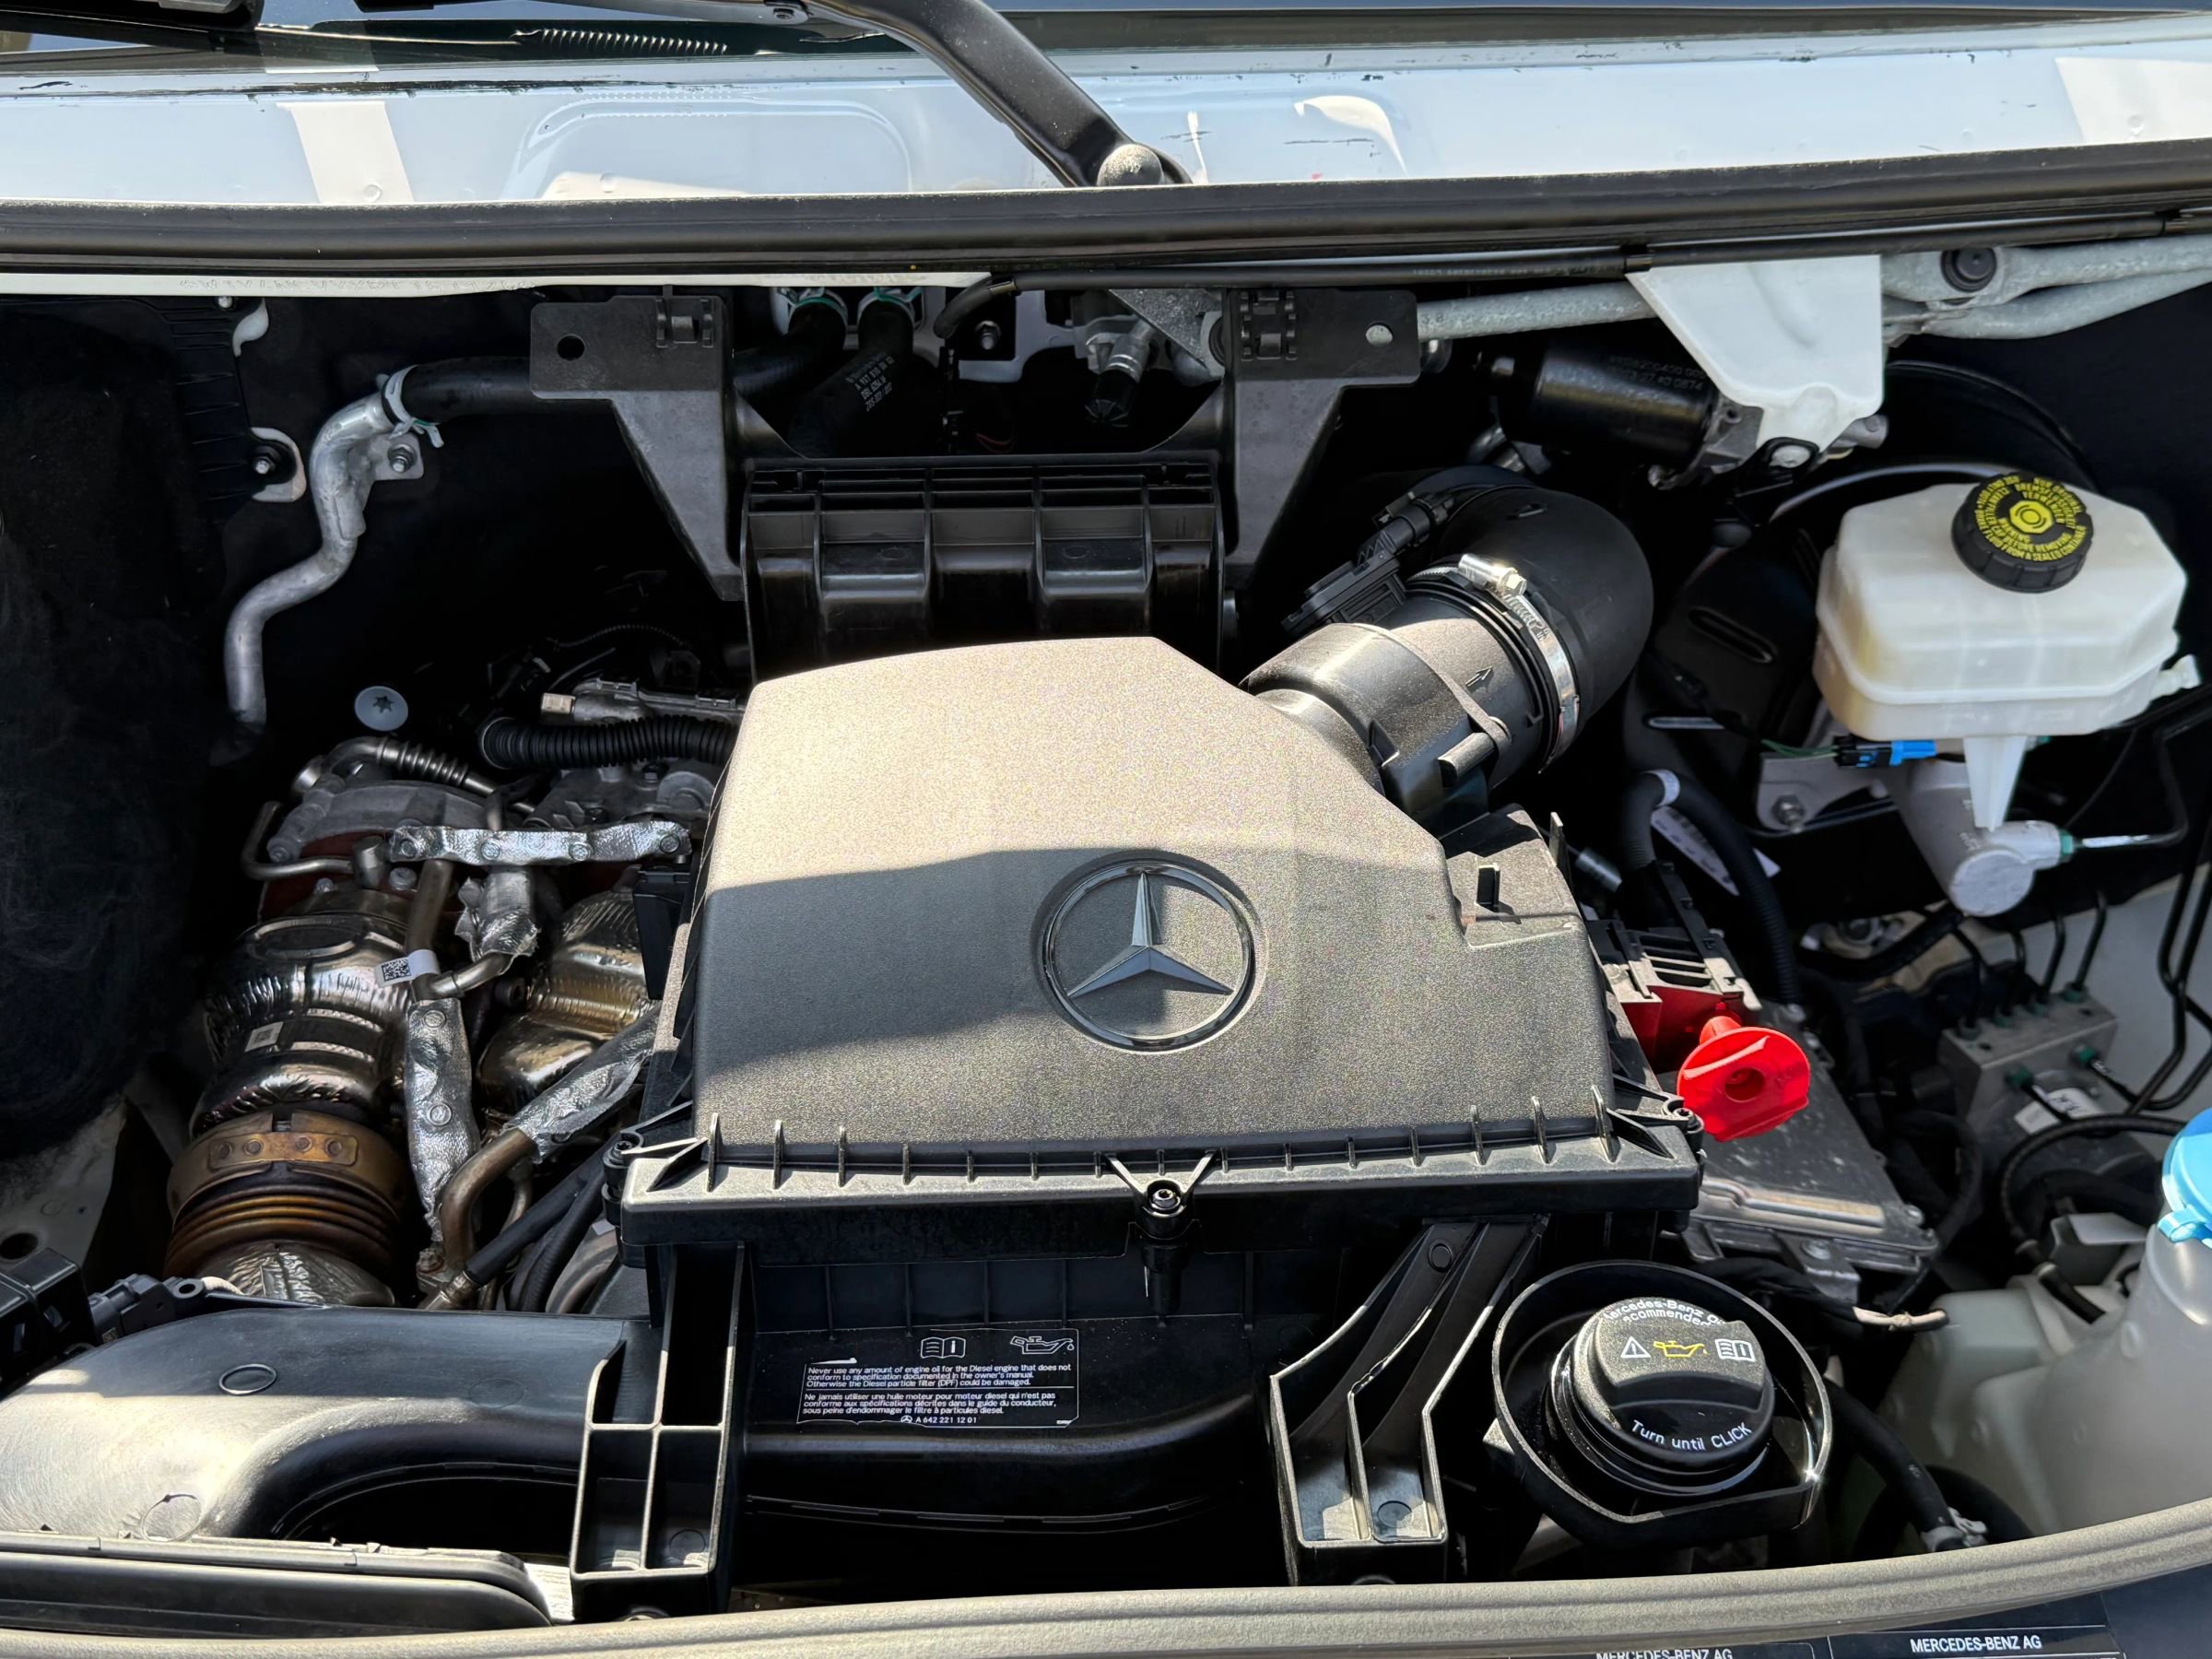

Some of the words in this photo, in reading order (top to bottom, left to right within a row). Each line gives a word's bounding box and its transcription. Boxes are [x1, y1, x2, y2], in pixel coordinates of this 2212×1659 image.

[1991, 525, 2007, 537] CAP
[2002, 536, 2034, 553] BEFORE
[2000, 544, 2026, 559] FROM
[2024, 552, 2033, 560] A
[849, 1368, 863, 1377] any
[904, 1366, 930, 1376] engine
[931, 1365, 941, 1373] oil
[942, 1365, 953, 1373] for
[970, 1364, 994, 1372] Diesel
[994, 1365, 1019, 1375] engine
[853, 1373, 901, 1383] specification
[902, 1371, 951, 1381] documented
[974, 1371, 1005, 1380] owner's
[806, 1380, 847, 1388] Otherwise
[887, 1380, 916, 1390] particle
[937, 1379, 959, 1388] (DPF)
[981, 1378, 992, 1386] be
[993, 1378, 1031, 1387] damaged.
[803, 1399, 842, 1407] conforme
[859, 1399, 913, 1409] spécifications
[947, 1399, 967, 1407] dans
[976, 1399, 998, 1409] guide
[1010, 1398, 1057, 1407] conducteur,
[804, 1393, 816, 1401] Ne
[817, 1393, 843, 1403] jamais
[844, 1393, 870, 1401] utiliser
[984, 1392, 1007, 1400] diesel
[1008, 1392, 1020, 1401] qui
[1041, 1393, 1056, 1402] pas
[822, 1406, 844, 1417] peine
[845, 1406, 903, 1416] d'endommager
[904, 1406, 912, 1414] le
[913, 1406, 933, 1414] filtre
[933, 1406, 940, 1414] à
[940, 1406, 979, 1416] particules
[979, 1406, 1005, 1415] diesel.
[1630, 1419, 1665, 1445] Turn
[1671, 1437, 1706, 1452] until
[1710, 1422, 1753, 1448] CLICK
[1910, 1635, 2021, 1653] MERCEDES-BENZ
[2023, 1634, 2042, 1650] AG
[1714, 1648, 1733, 1659] AG
